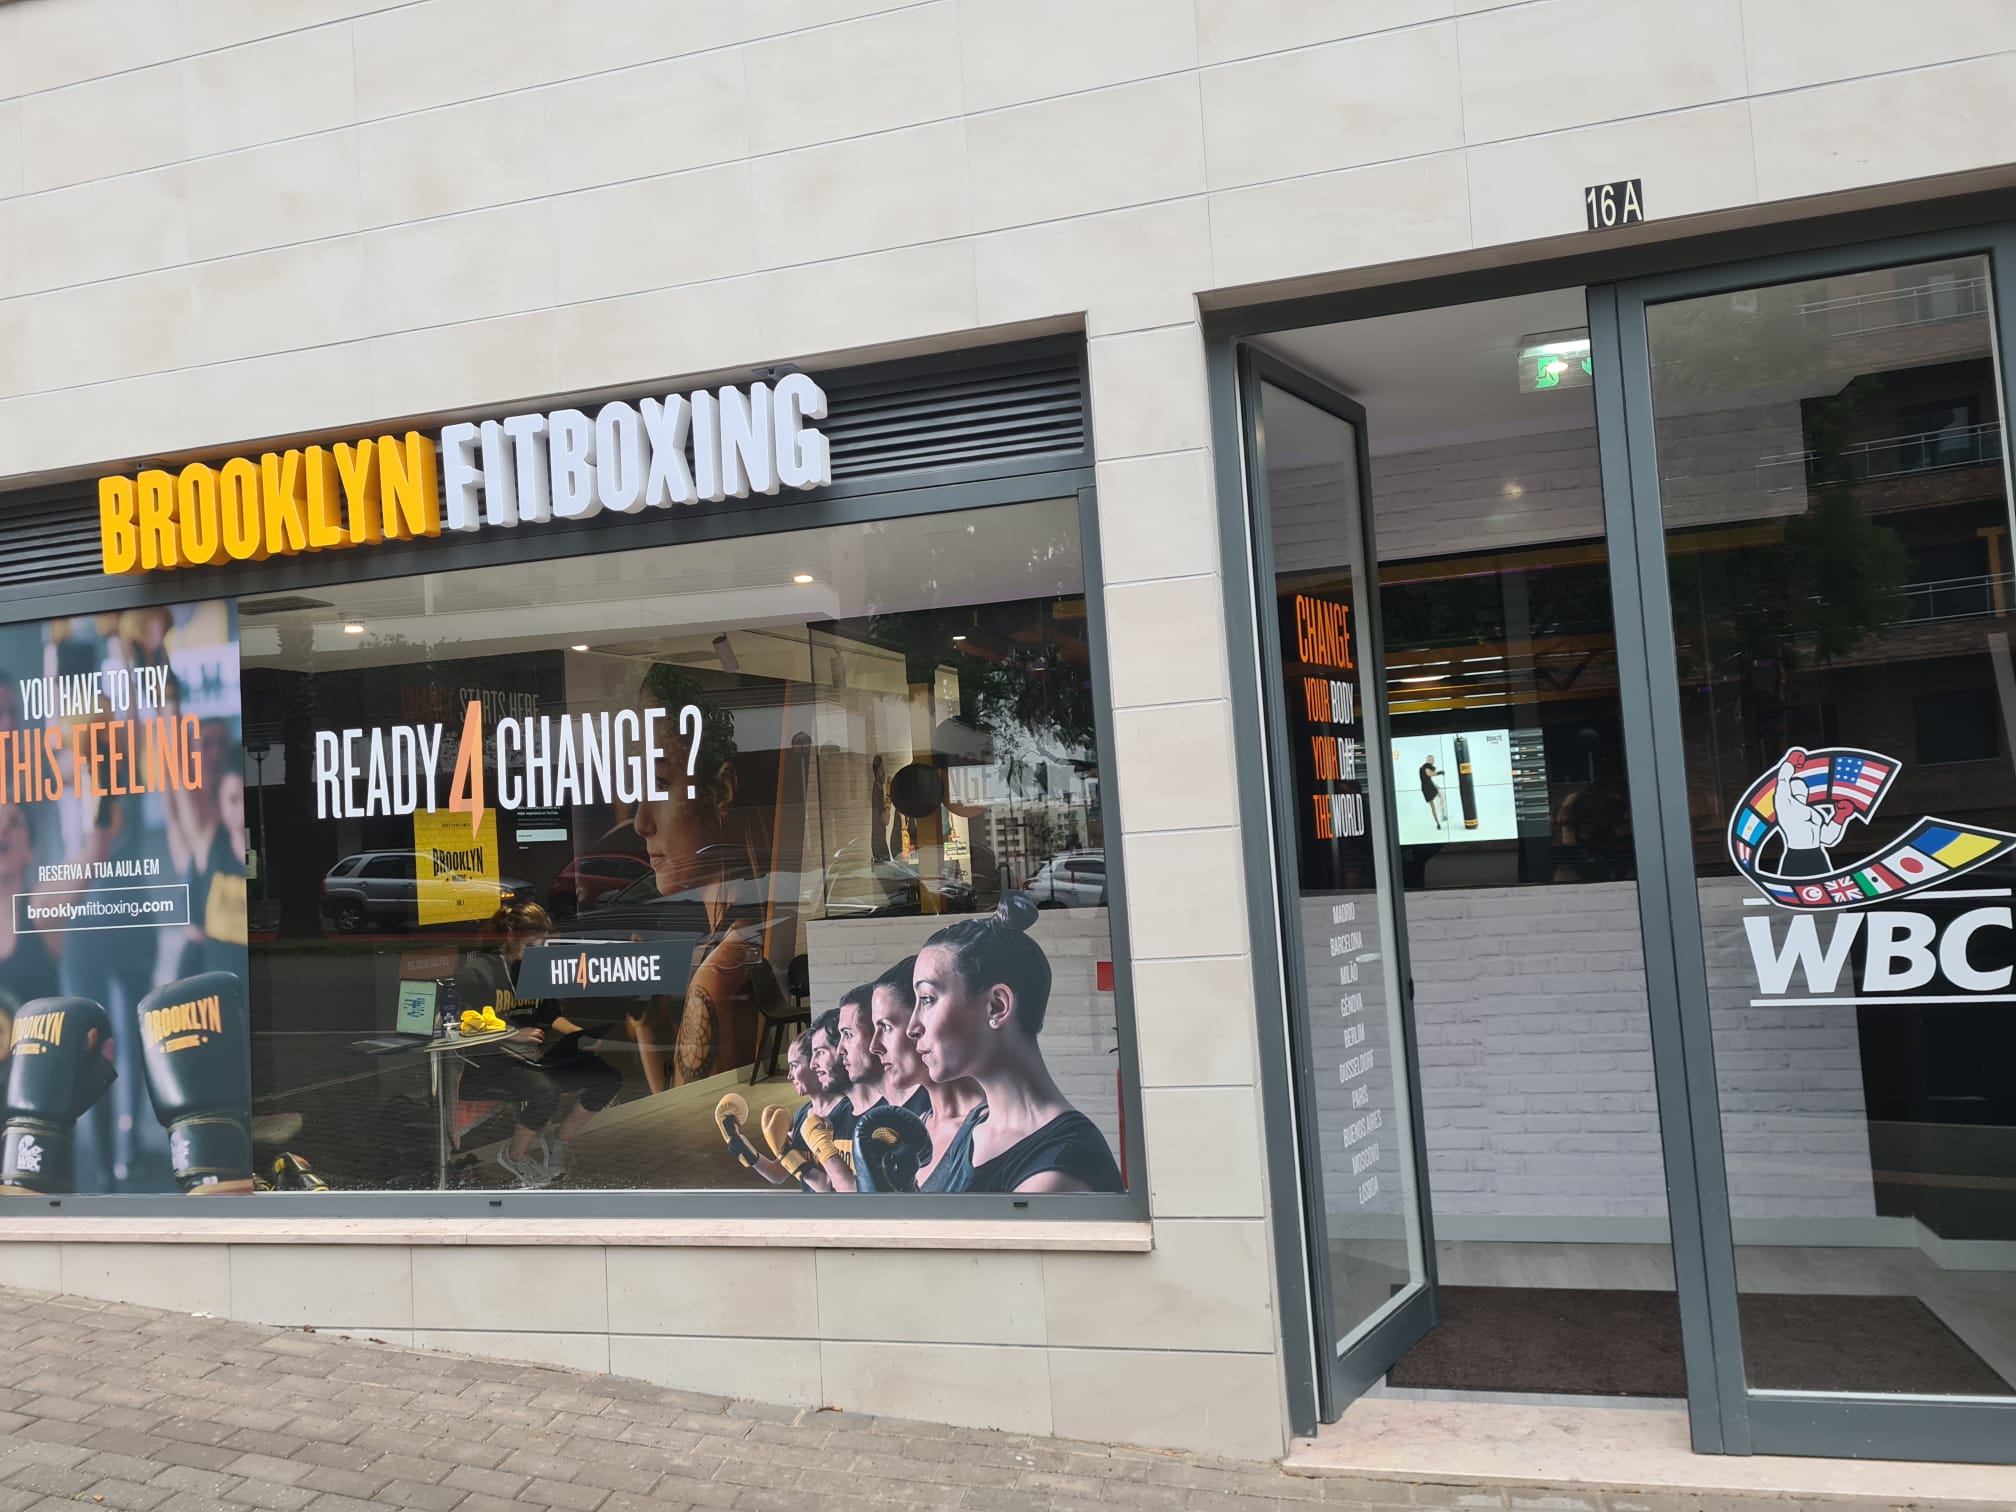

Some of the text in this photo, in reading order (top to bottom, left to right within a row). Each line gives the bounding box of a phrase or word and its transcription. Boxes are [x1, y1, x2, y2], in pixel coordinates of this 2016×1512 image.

[1587, 180, 1643, 229] 16 A
[99, 373, 829, 575] BROOKLYN FITBOXING
[1296, 594, 1354, 669] CHANGE
[20, 664, 169, 720] YOU HAVE TO TRY
[1304, 676, 1354, 725] YOUR BODY
[0, 713, 203, 805] THIS FEELING
[315, 723, 443, 820] READY
[449, 700, 485, 840] 4
[497, 706, 670, 810] CHANGE
[1311, 736, 1339, 780] YOUR
[1312, 793, 1365, 839] THE WORLD
[39, 858, 160, 882] RESERVA A TUA AULA EM
[432, 846, 484, 877] BROOKLYN
[27, 900, 174, 919] brooklynfitboxing.com
[1332, 902, 1356, 925] MADRID
[1329, 930, 1364, 958] BARCELONA
[1743, 907, 2014, 994] WBC
[144, 995, 222, 1048] BROOKLYN
[1352, 1084, 1369, 1110] PARIS
[1359, 1175, 1379, 1205] LISBOA
